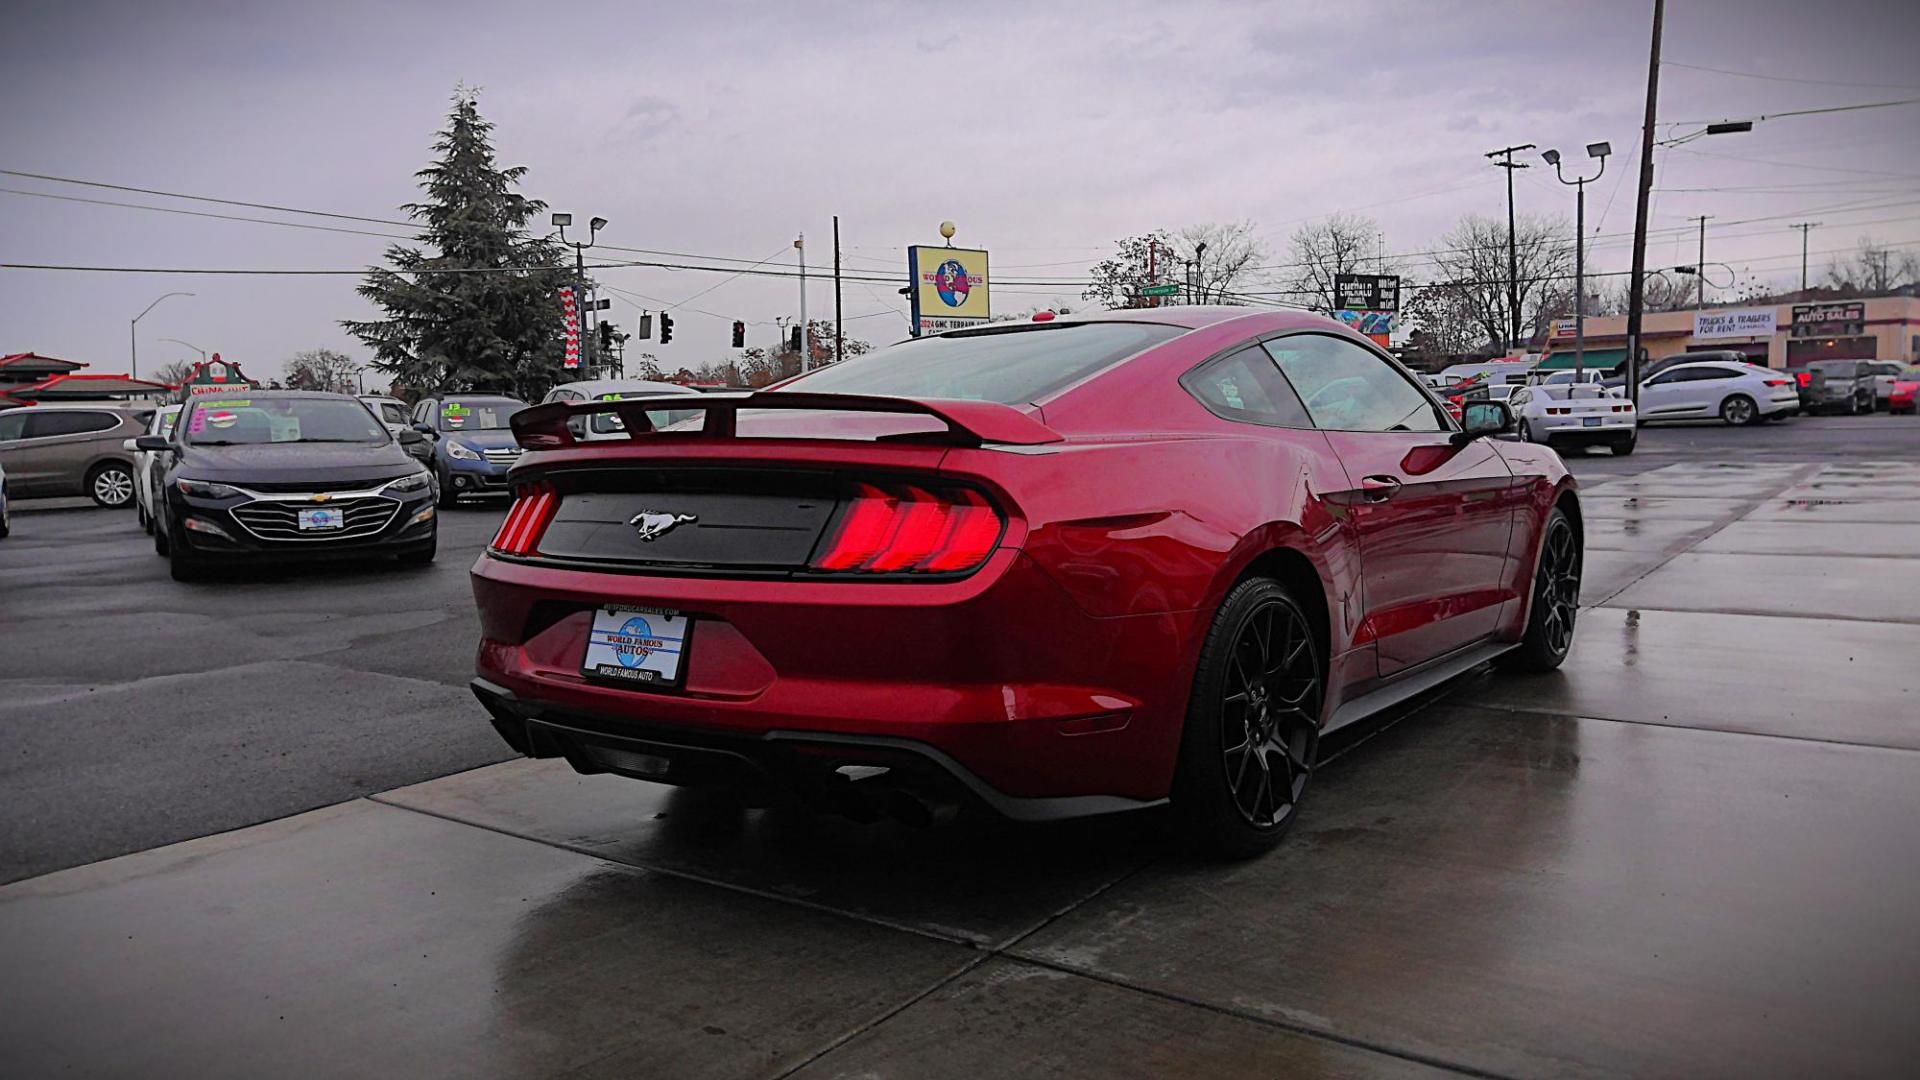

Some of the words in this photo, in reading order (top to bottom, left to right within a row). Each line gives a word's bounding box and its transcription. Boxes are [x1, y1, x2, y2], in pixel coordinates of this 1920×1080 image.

[1340, 283, 1372, 296] EMERALD
[1798, 311, 1825, 323] AUTO
[1827, 310, 1860, 321] SALES
[935, 320, 948, 329] GMC
[1699, 325, 1714, 334] FOR
[1717, 324, 1735, 333] RENT
[607, 636, 633, 644] WORLD
[634, 638, 663, 648] FAMOUS
[617, 646, 649, 656] AUTOS
[600, 666, 617, 676] WORLD
[617, 667, 638, 679] FAMOUS
[638, 671, 653, 681] AUTO
